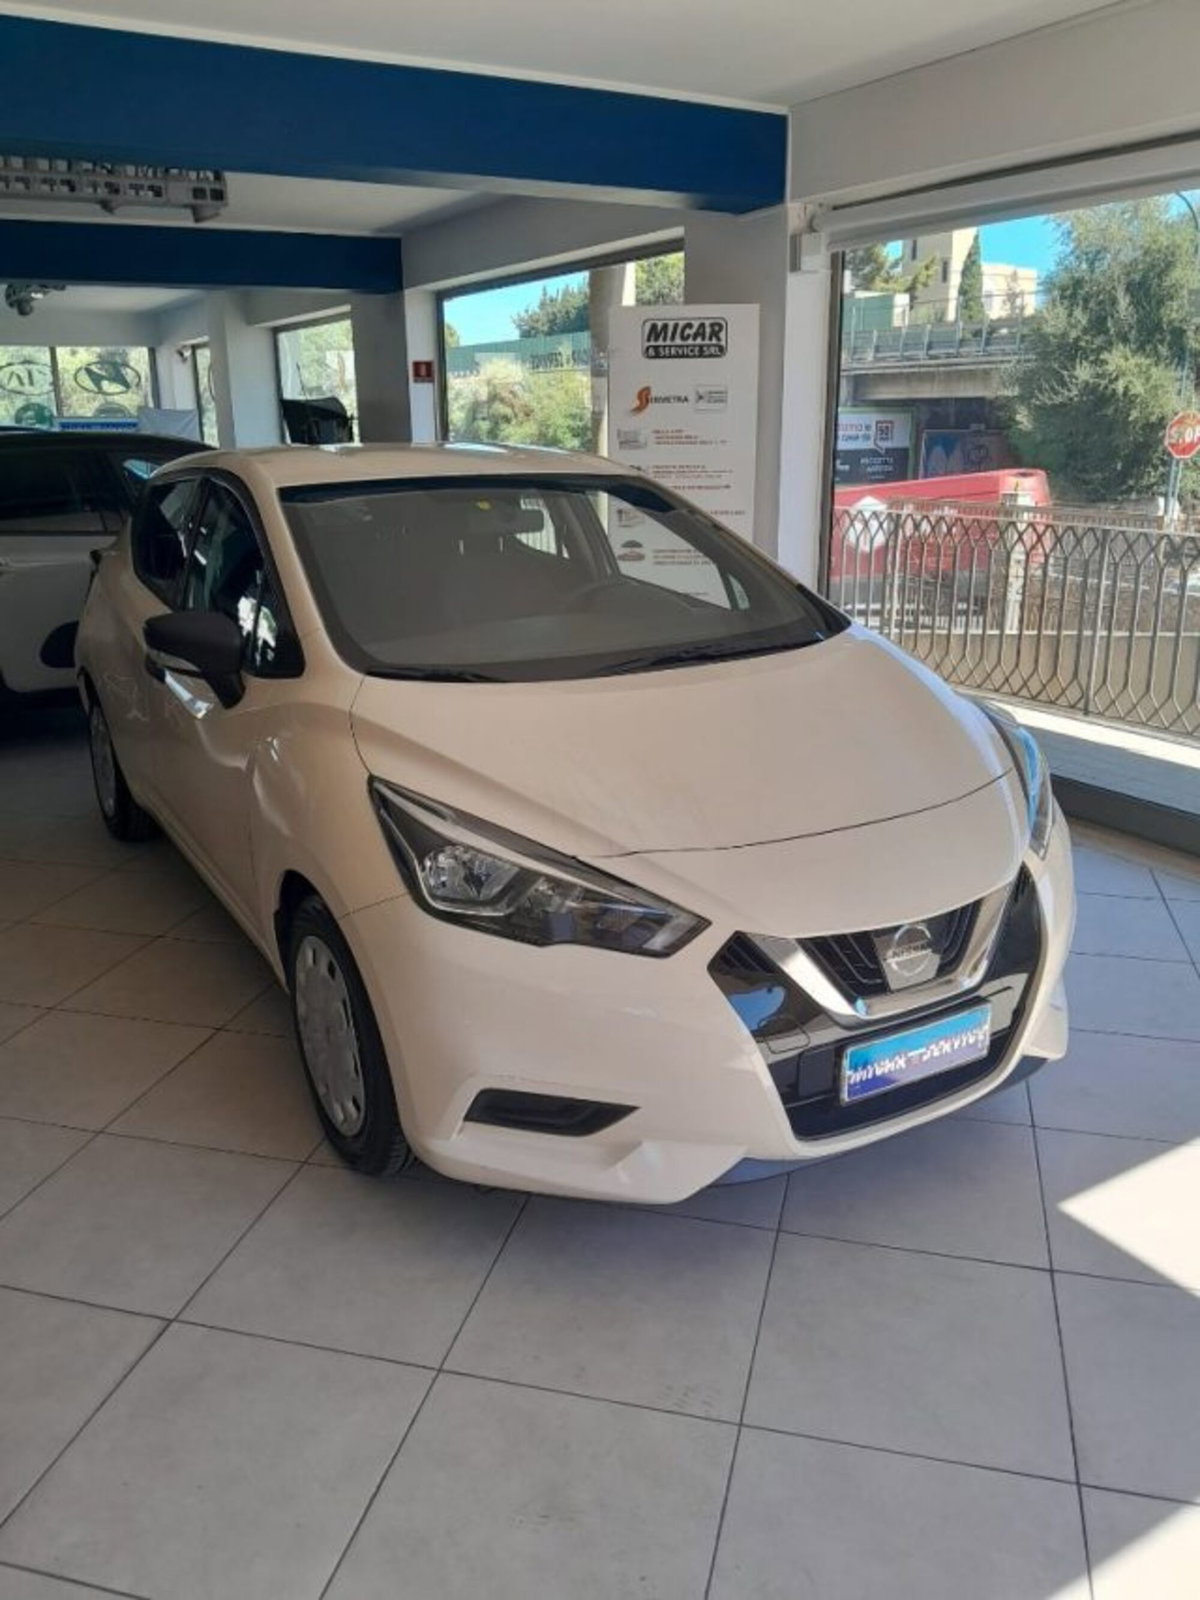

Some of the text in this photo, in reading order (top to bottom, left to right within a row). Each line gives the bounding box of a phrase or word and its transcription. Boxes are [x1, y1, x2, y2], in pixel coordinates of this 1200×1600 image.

[646, 322, 723, 342] MICAR
[658, 346, 699, 357] SERVICE
[703, 345, 720, 355] SRL
